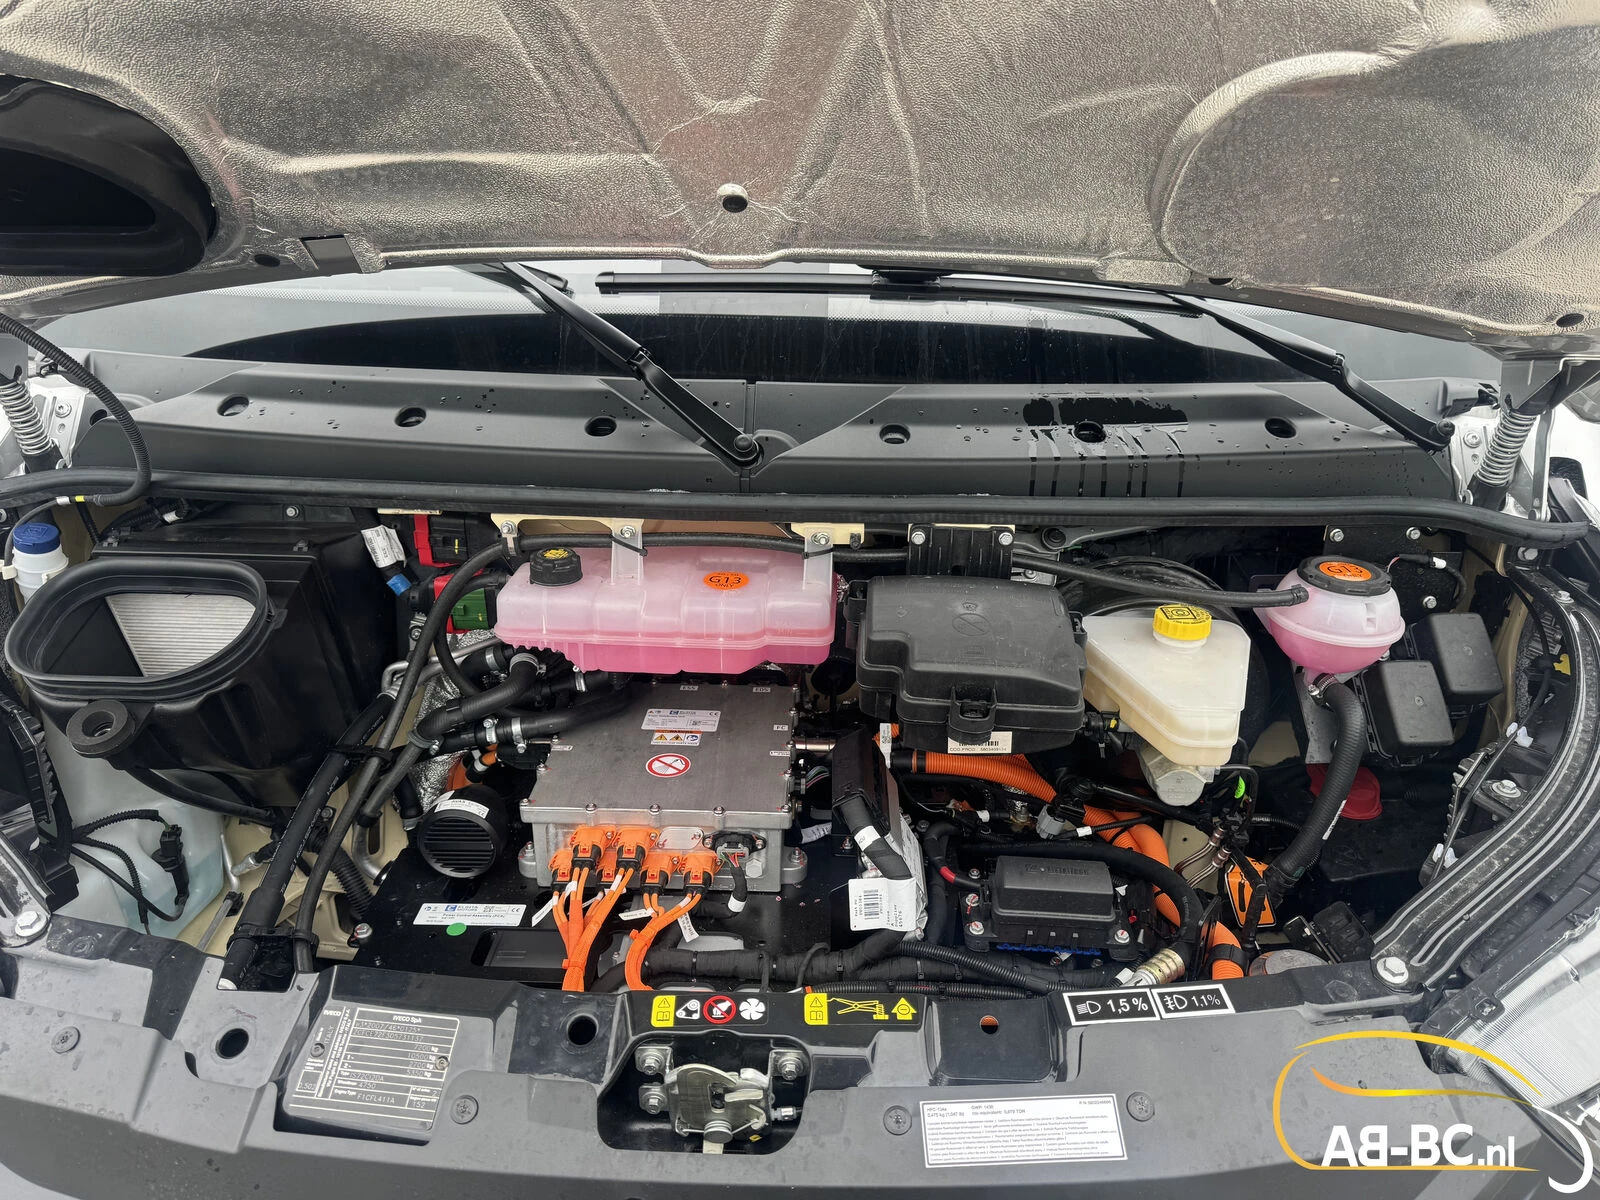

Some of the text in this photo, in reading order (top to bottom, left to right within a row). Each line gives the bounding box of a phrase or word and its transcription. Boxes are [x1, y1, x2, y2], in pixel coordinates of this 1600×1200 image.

[1327, 566, 1362, 574] G13
[709, 576, 741, 584] G13
[1107, 998, 1149, 1014] 1,5 %
[324, 1026, 334, 1044] ITALY
